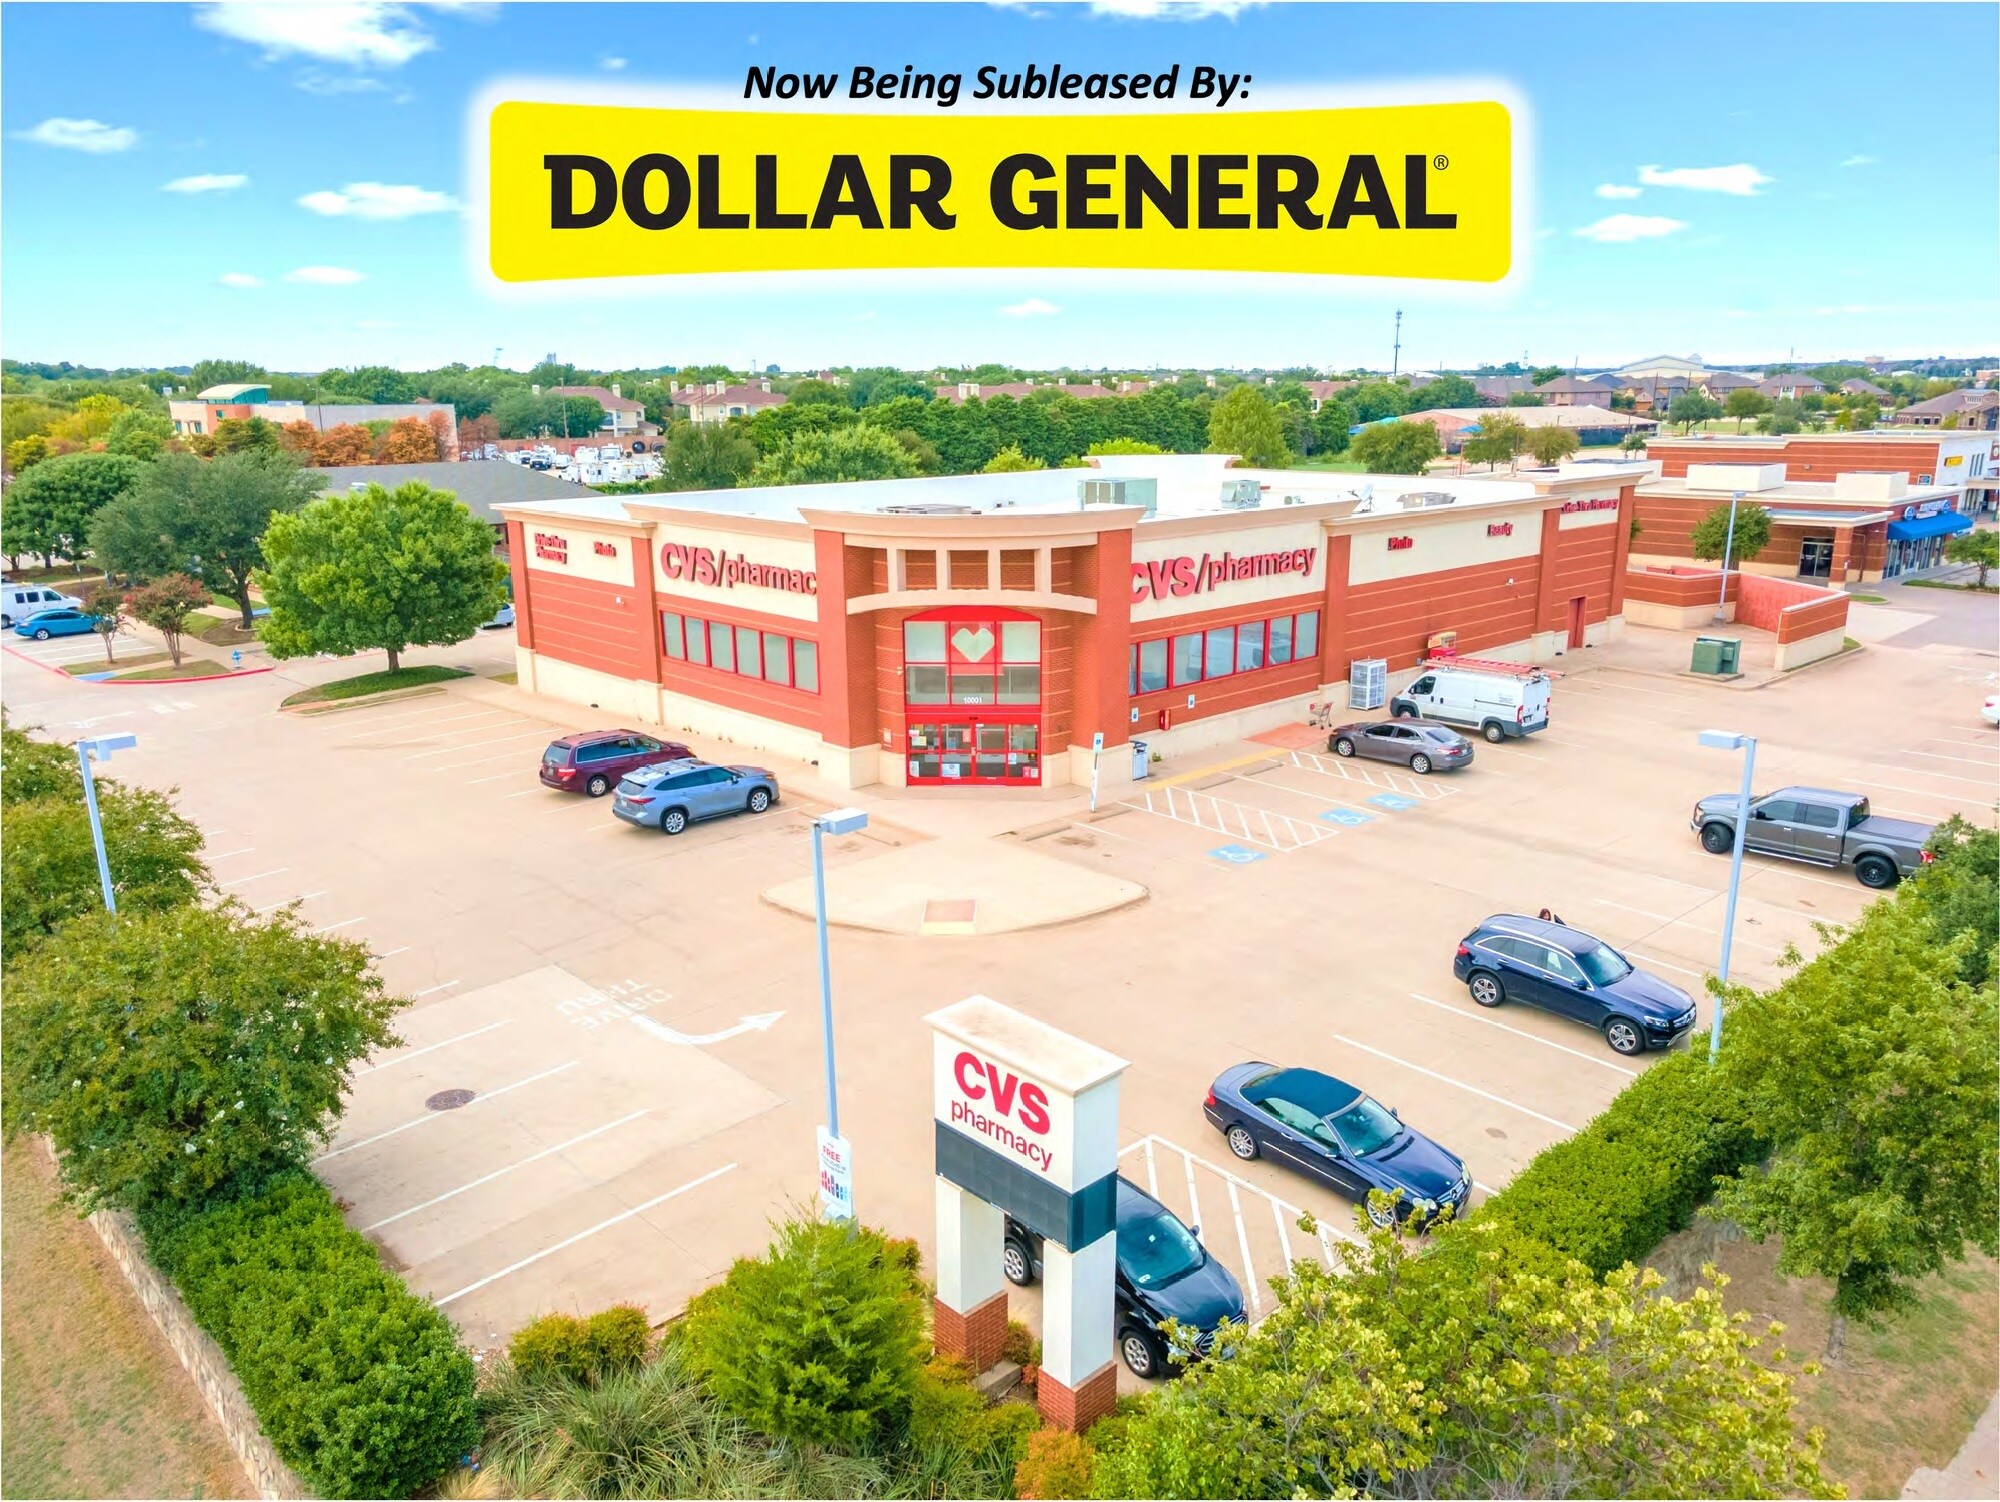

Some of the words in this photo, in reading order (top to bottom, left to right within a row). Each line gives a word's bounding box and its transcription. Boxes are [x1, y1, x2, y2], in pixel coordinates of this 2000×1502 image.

[1388, 536, 1413, 550] Photo
[1487, 523, 1513, 536] Beauty
[660, 542, 817, 596] CVS/pharmac
[1130, 547, 1318, 604] CVS/pharmacy
[963, 696, 983, 705] 10001
[954, 1052, 1050, 1135] CVS
[822, 1144, 841, 1163] FREE
[951, 1099, 1053, 1172] pharmacy
